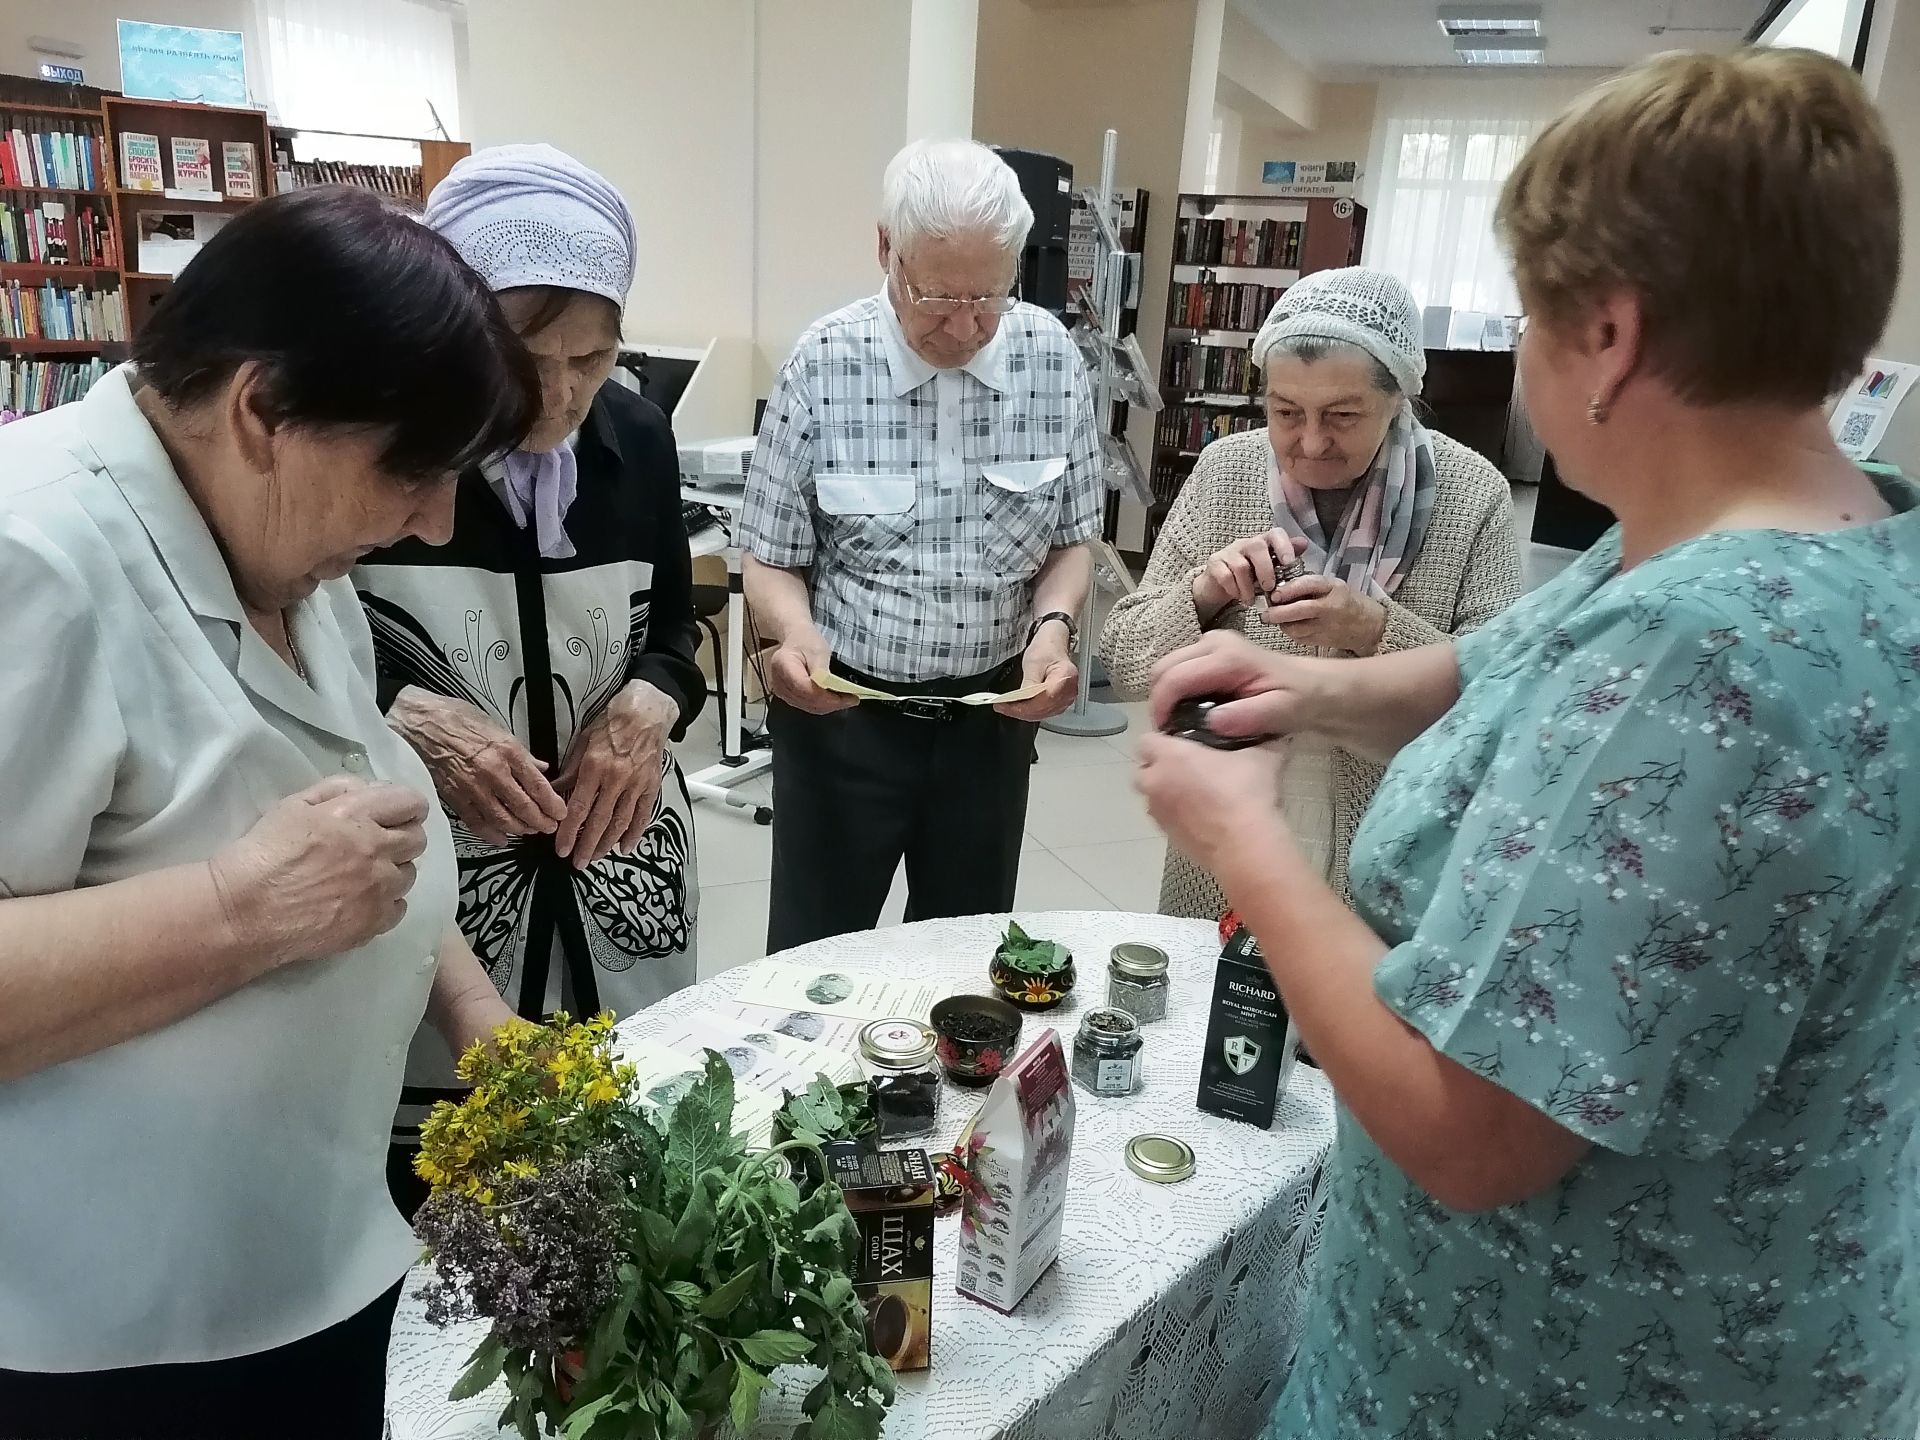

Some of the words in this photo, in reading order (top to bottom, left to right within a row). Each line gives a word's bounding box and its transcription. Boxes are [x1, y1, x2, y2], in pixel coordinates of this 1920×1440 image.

[41, 64, 82, 81] ВЫХОД
[129, 156, 157, 165] БРОСИТЬ
[177, 162, 207, 170] БРОСИТЬ
[129, 163, 158, 173] КУРИТЬ
[178, 170, 207, 179] КУРИТЬ
[1334, 202, 1352, 214] 16+
[1228, 981, 1276, 1001] RICHARD
[1222, 999, 1241, 1009] ROYAL
[1241, 1005, 1277, 1018] MOROCCAN
[1240, 1011, 1256, 1019] MINT
[1231, 1041, 1238, 1050] R
[1243, 1058, 1250, 1067] T
[907, 1150, 927, 1181] SHAH
[871, 1235, 880, 1260] GOLD
[881, 1215, 904, 1277] ШАХ
